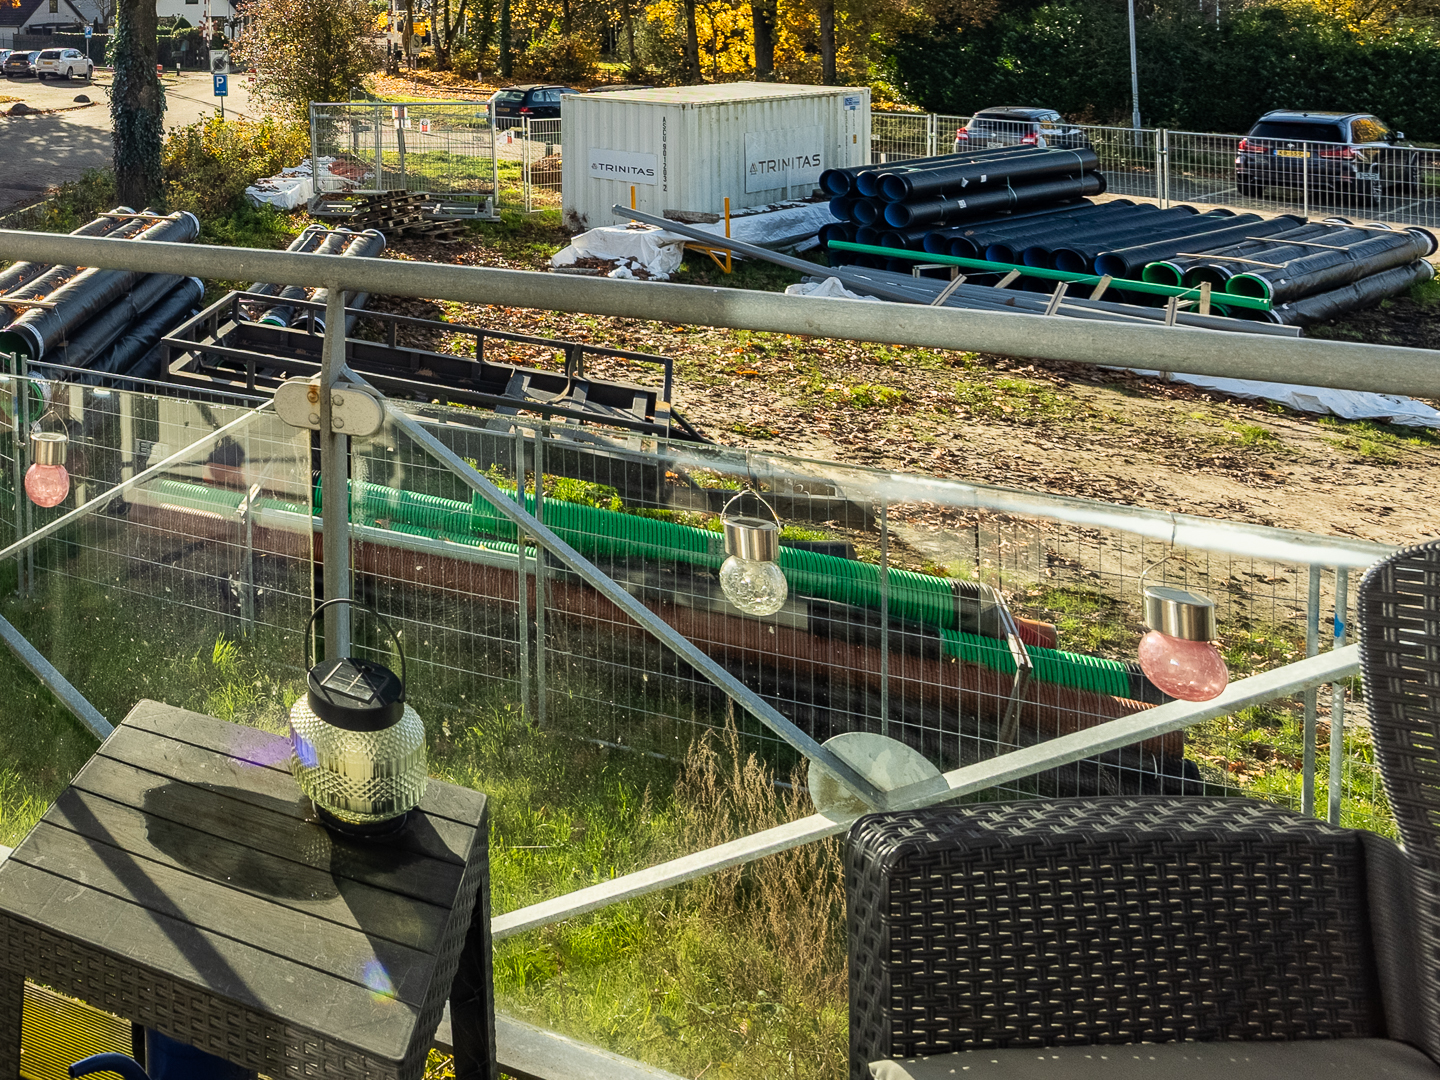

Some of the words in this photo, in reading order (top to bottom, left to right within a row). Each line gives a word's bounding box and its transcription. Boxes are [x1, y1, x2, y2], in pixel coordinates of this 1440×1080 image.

[216, 77, 224, 88] P
[598, 162, 655, 176] TRINITAS
[758, 154, 821, 174] TRINITAS
